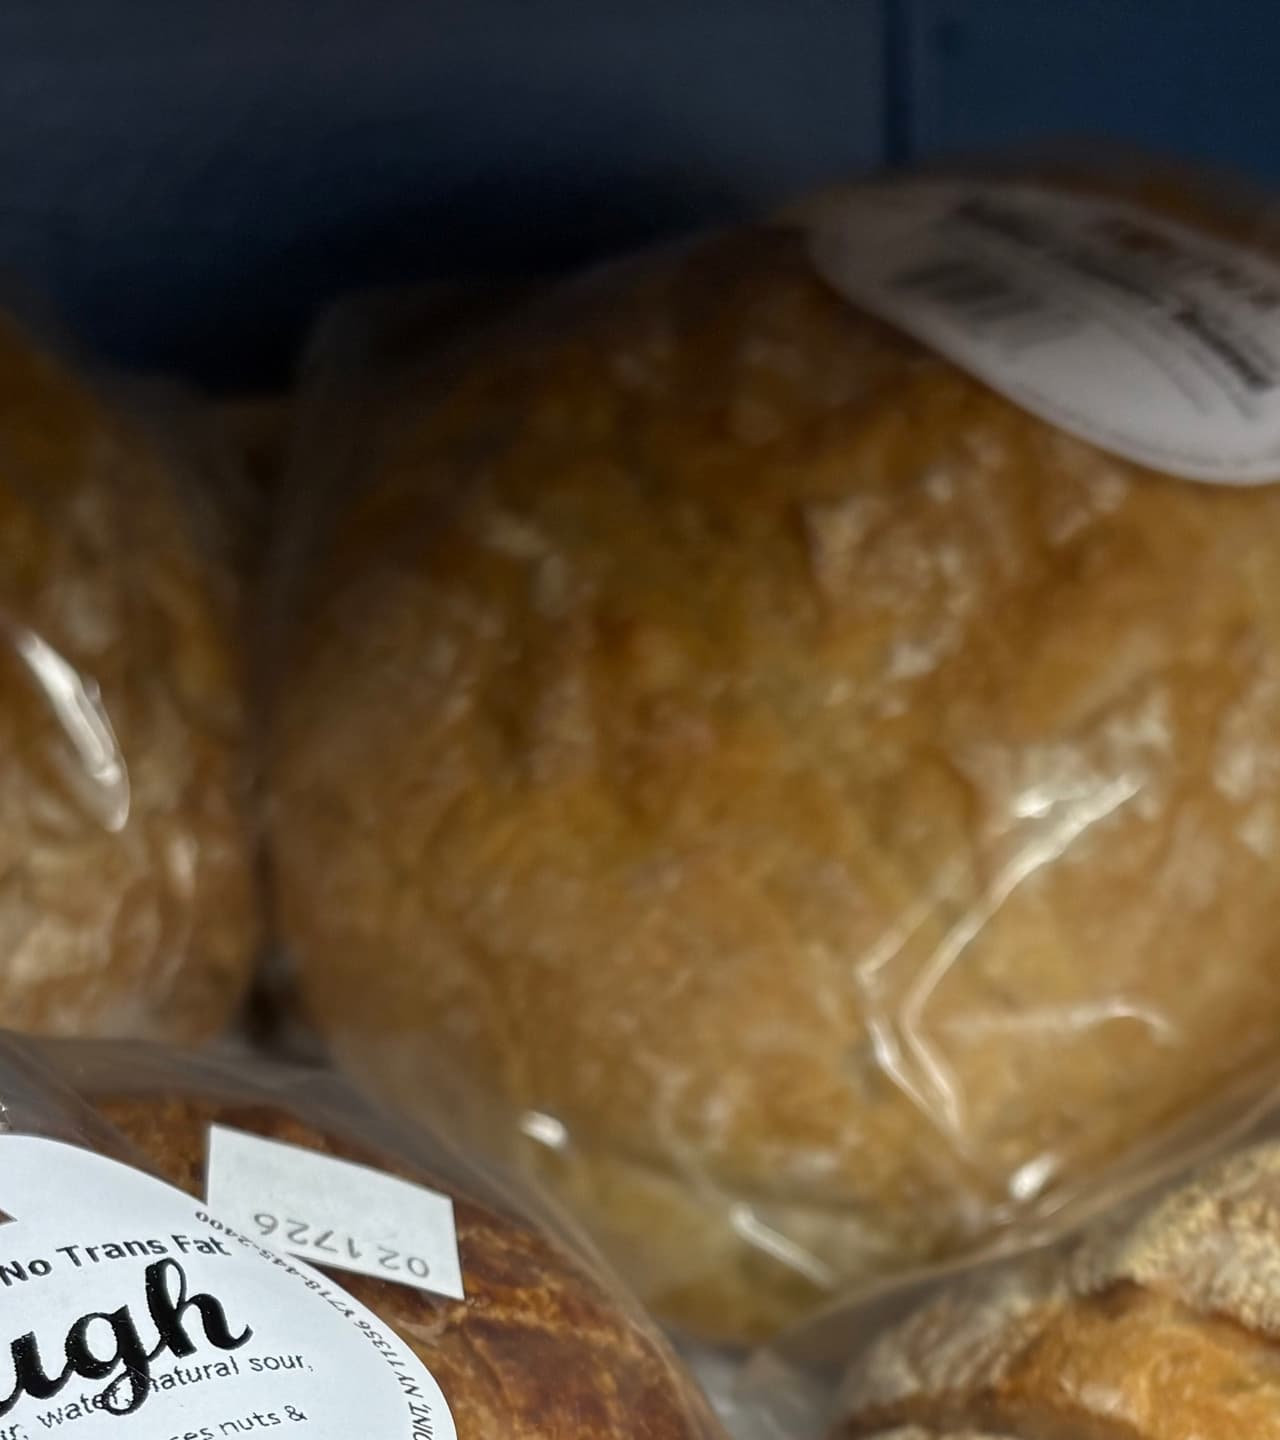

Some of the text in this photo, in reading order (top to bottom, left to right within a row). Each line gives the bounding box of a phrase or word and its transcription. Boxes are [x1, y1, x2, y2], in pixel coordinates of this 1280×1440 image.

[55, 1234, 169, 1269] Trans
[173, 1232, 234, 1258] Fat
[353, 1318, 405, 1372] 11356
[148, 1355, 240, 1393] natural
[395, 1371, 425, 1400] NY
[218, 1409, 282, 1438] nuts
[284, 1403, 310, 1424] &
